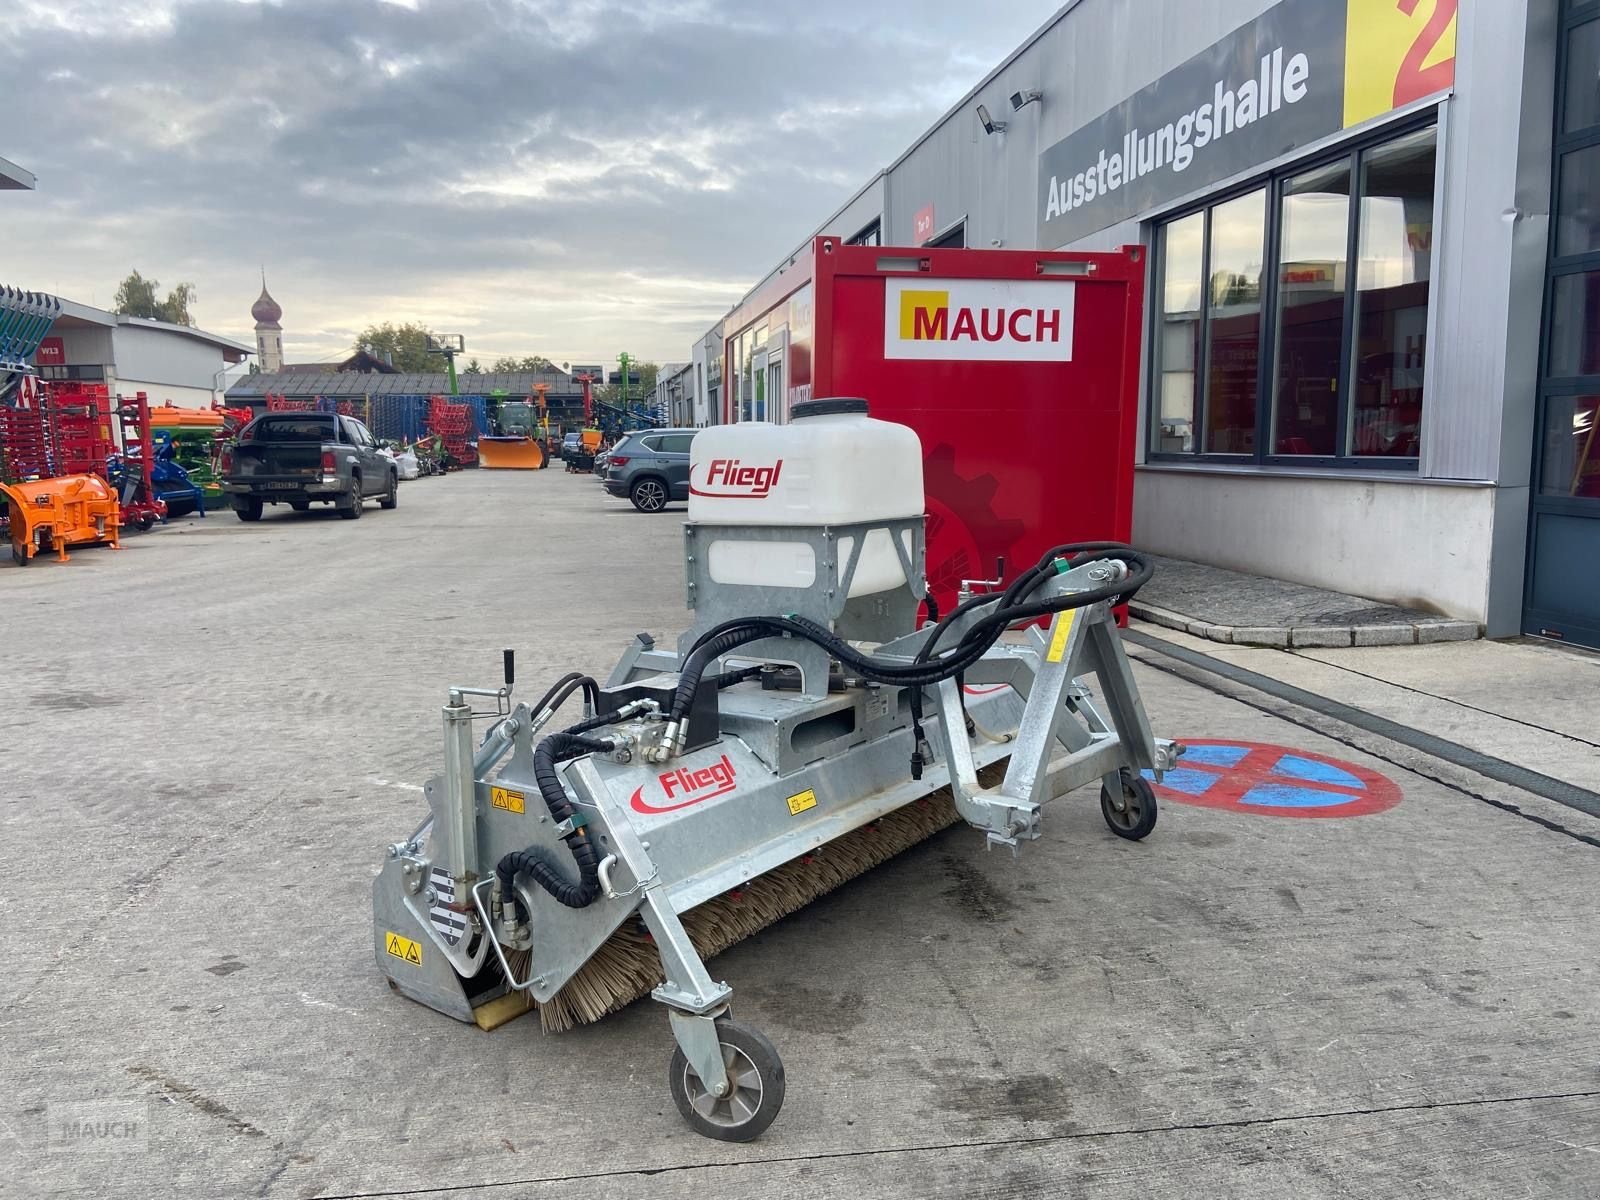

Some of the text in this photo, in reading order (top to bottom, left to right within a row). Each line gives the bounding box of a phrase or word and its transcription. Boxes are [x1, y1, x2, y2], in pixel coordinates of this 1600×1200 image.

[1045, 46, 1309, 221] Ausstellungshalle
[914, 306, 1060, 343] MAUCH
[706, 458, 784, 493] Fliegl
[658, 755, 736, 799] Fliegl
